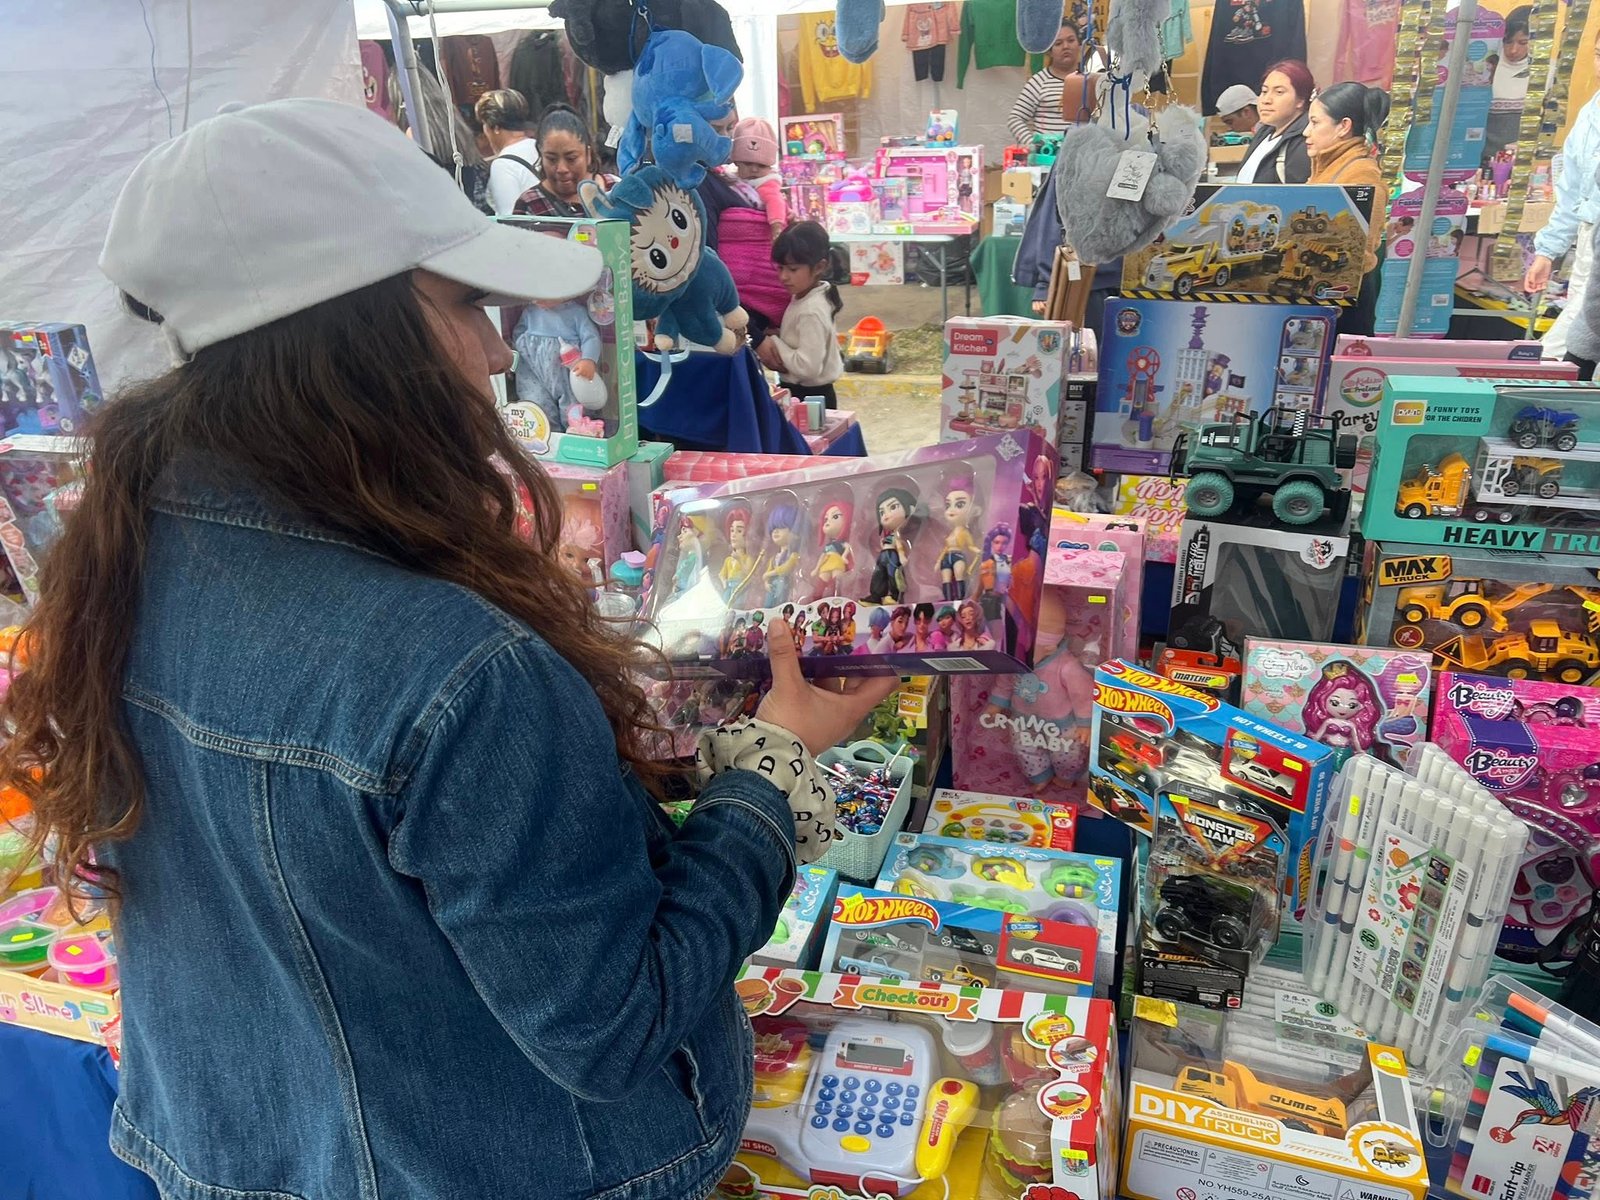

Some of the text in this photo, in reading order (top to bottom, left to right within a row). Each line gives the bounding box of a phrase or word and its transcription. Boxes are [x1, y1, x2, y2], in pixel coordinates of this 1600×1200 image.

[618, 247, 631, 304] Baby
[953, 332, 984, 341] Dream
[953, 343, 988, 353] Kitchen
[511, 408, 525, 418] my
[1331, 410, 1379, 432] Party
[1443, 526, 1540, 548] HEAVY
[1384, 557, 1438, 578] MAX
[1392, 574, 1430, 582] TRUCK
[1173, 671, 1216, 683] MATCH
[979, 713, 1061, 738] CRYING
[1231, 715, 1256, 727] HOT
[1253, 724, 1295, 744] WHEELS
[1020, 731, 1074, 753] BABY
[1466, 750, 1536, 781] Beauty
[1184, 813, 1256, 844] MONSTER
[1203, 831, 1236, 847] JAM
[1362, 930, 1377, 948] 36
[20, 992, 74, 1021] Slime
[863, 988, 950, 1008] Checkout
[1319, 1002, 1334, 1015] 36
[844, 1091, 850, 1099] 5
[1140, 1093, 1203, 1124] DIY
[1210, 1110, 1273, 1128] ASSEMBLING
[1200, 1116, 1279, 1144] TRUCK
